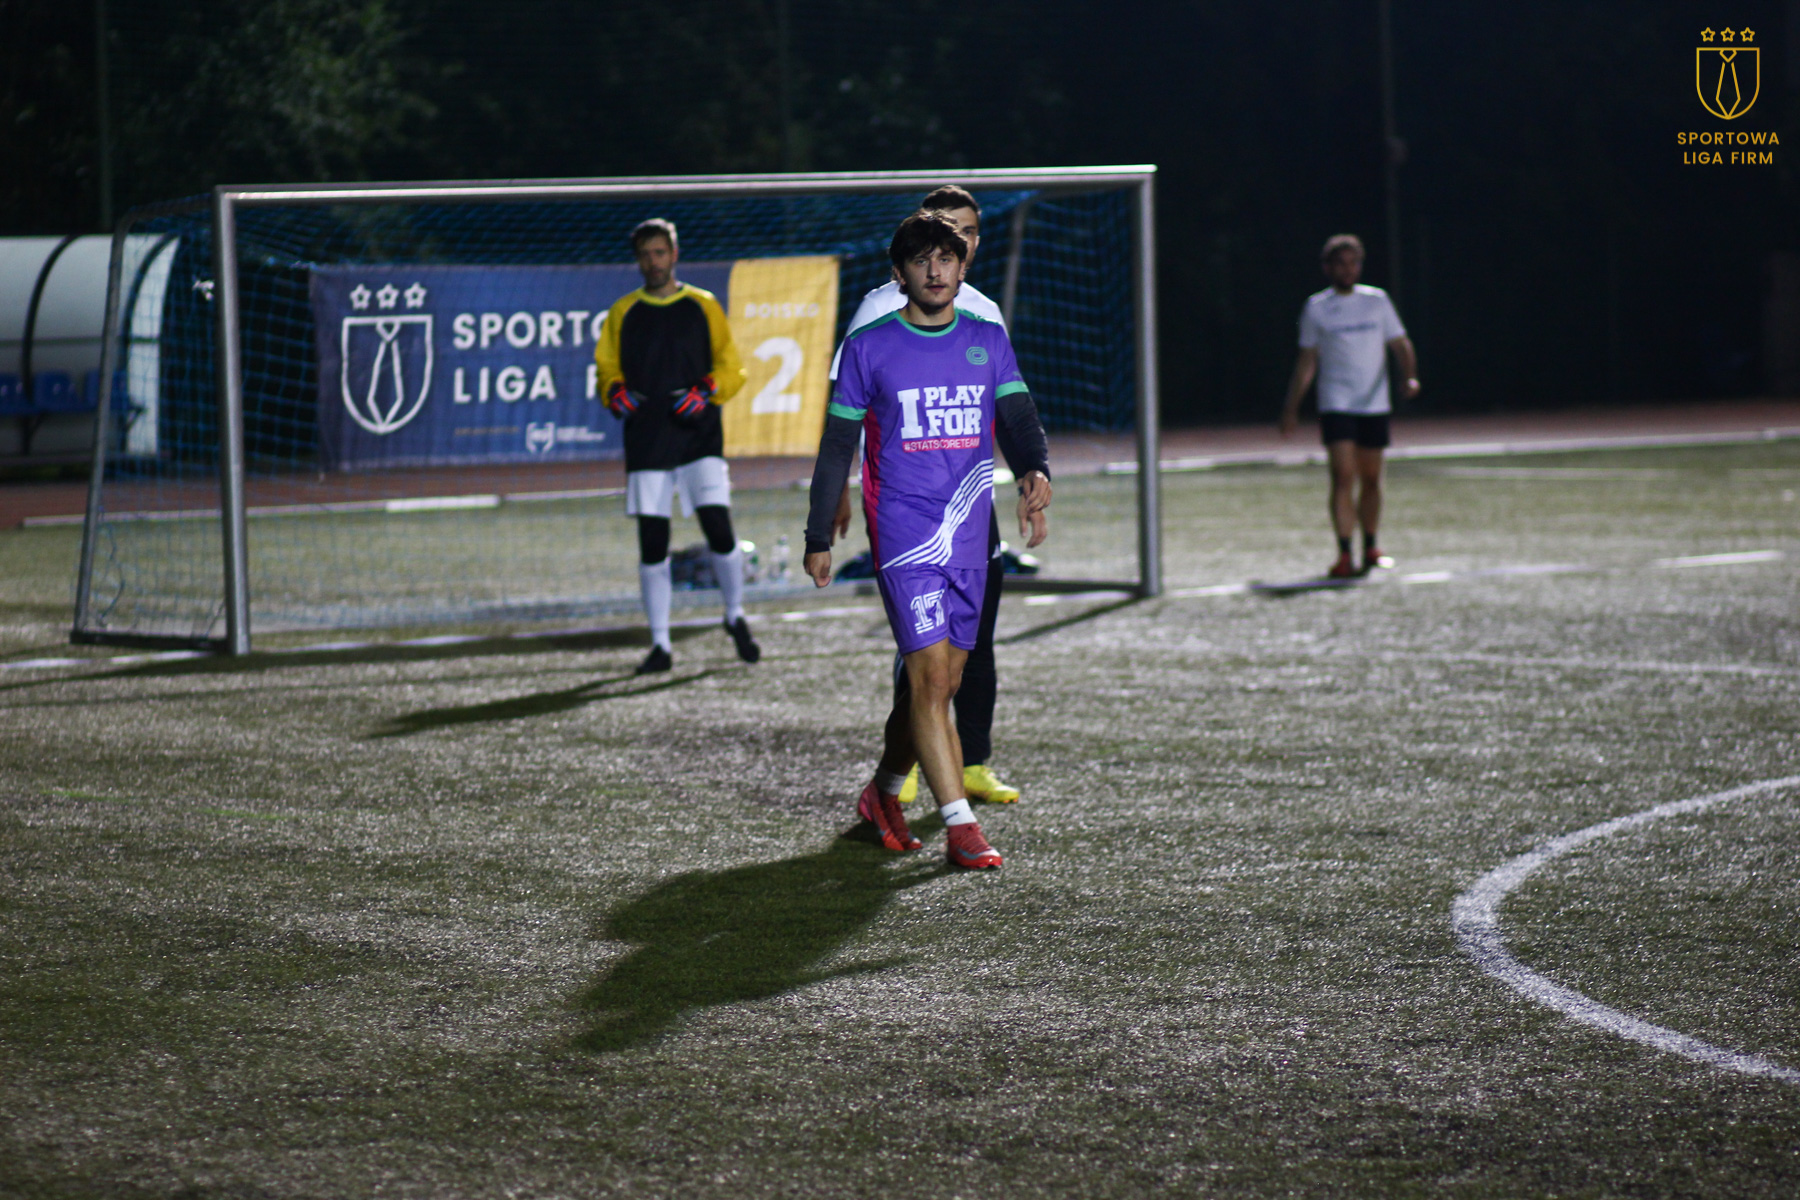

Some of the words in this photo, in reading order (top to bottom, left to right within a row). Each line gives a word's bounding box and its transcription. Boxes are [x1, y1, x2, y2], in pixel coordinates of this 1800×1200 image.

[745, 303, 819, 318] BOISKO
[453, 365, 556, 404] LIGA
[751, 337, 803, 414] 2
[897, 388, 923, 439] I
[924, 385, 986, 407] PLAY
[926, 407, 982, 437] FOR
[910, 588, 945, 634] 17
